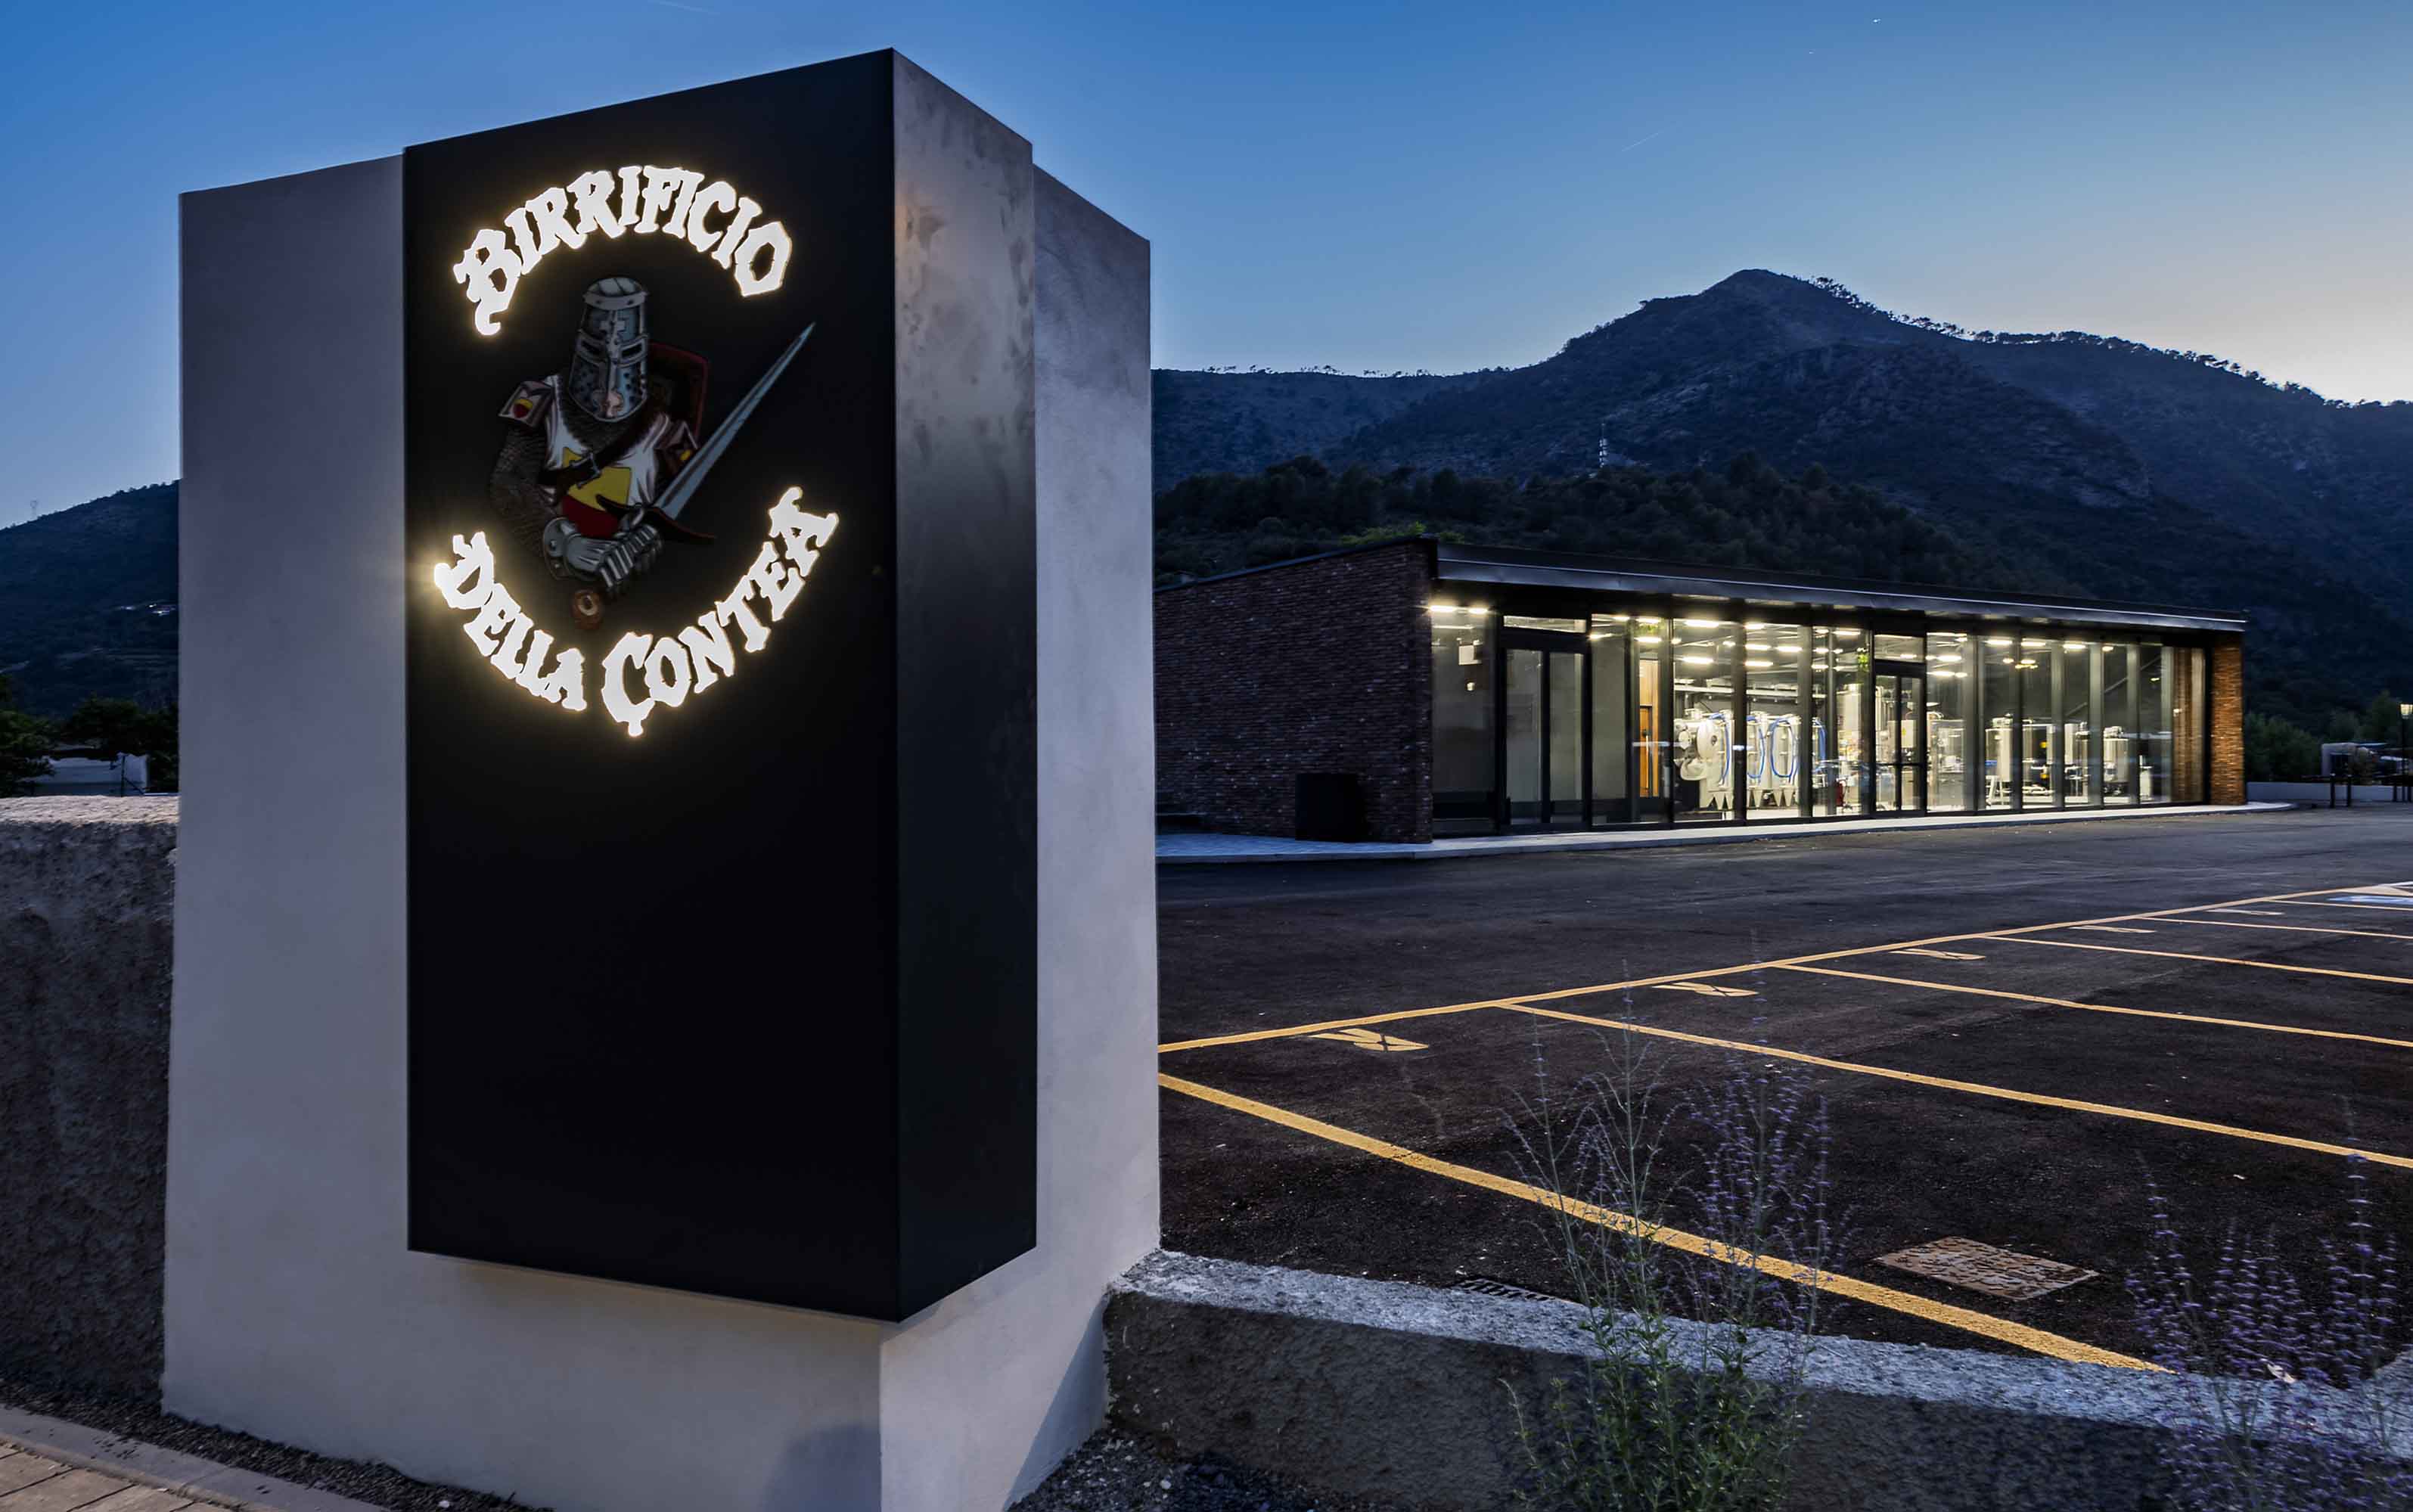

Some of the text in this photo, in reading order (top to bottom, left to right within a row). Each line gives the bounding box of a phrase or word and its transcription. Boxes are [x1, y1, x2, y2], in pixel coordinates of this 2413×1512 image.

[453, 165, 792, 335] BIRRIFICIO
[433, 487, 838, 737] DELLA CONTEA
